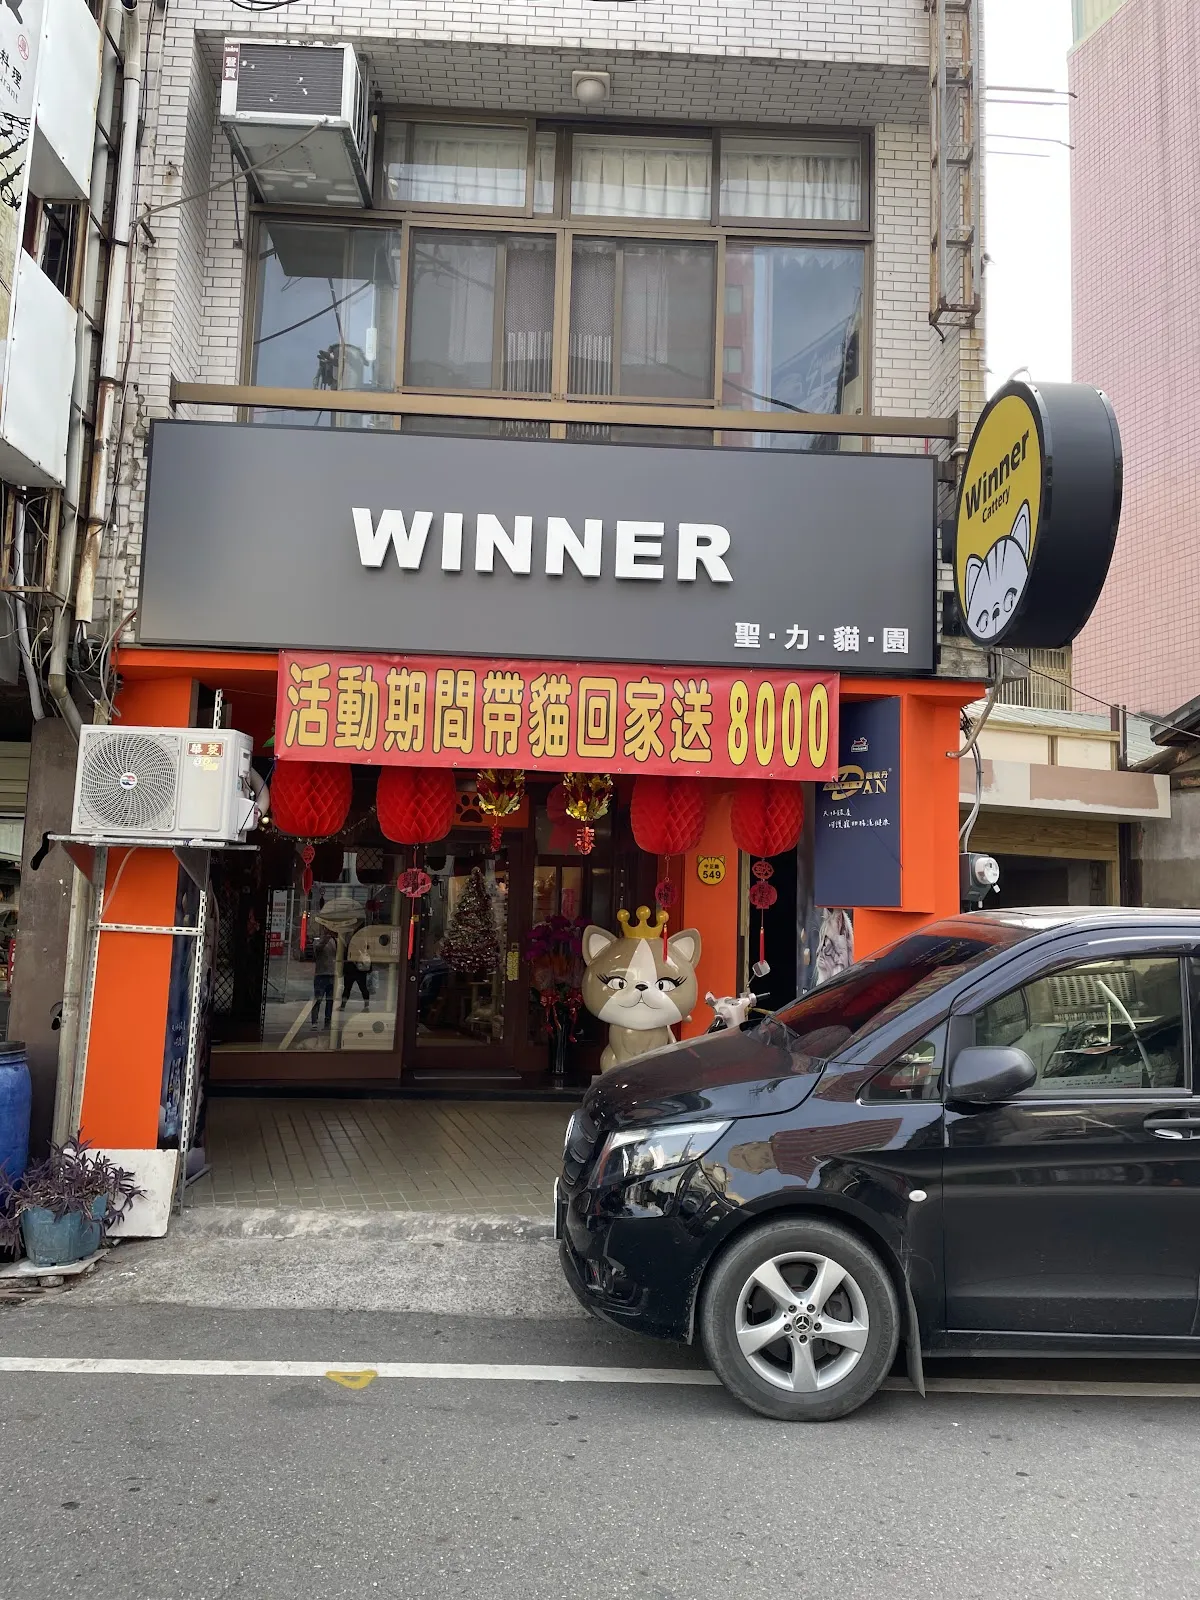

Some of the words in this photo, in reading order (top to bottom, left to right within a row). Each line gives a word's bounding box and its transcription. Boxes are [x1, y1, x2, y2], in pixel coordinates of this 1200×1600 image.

[965, 429, 1029, 520] Winner
[982, 486, 1010, 523] Cattery
[351, 507, 734, 583] WINNER
[190, 744, 219, 755] 華菱
[285, 661, 714, 764] 活動期間帶貓回家送
[727, 679, 830, 769] 8000
